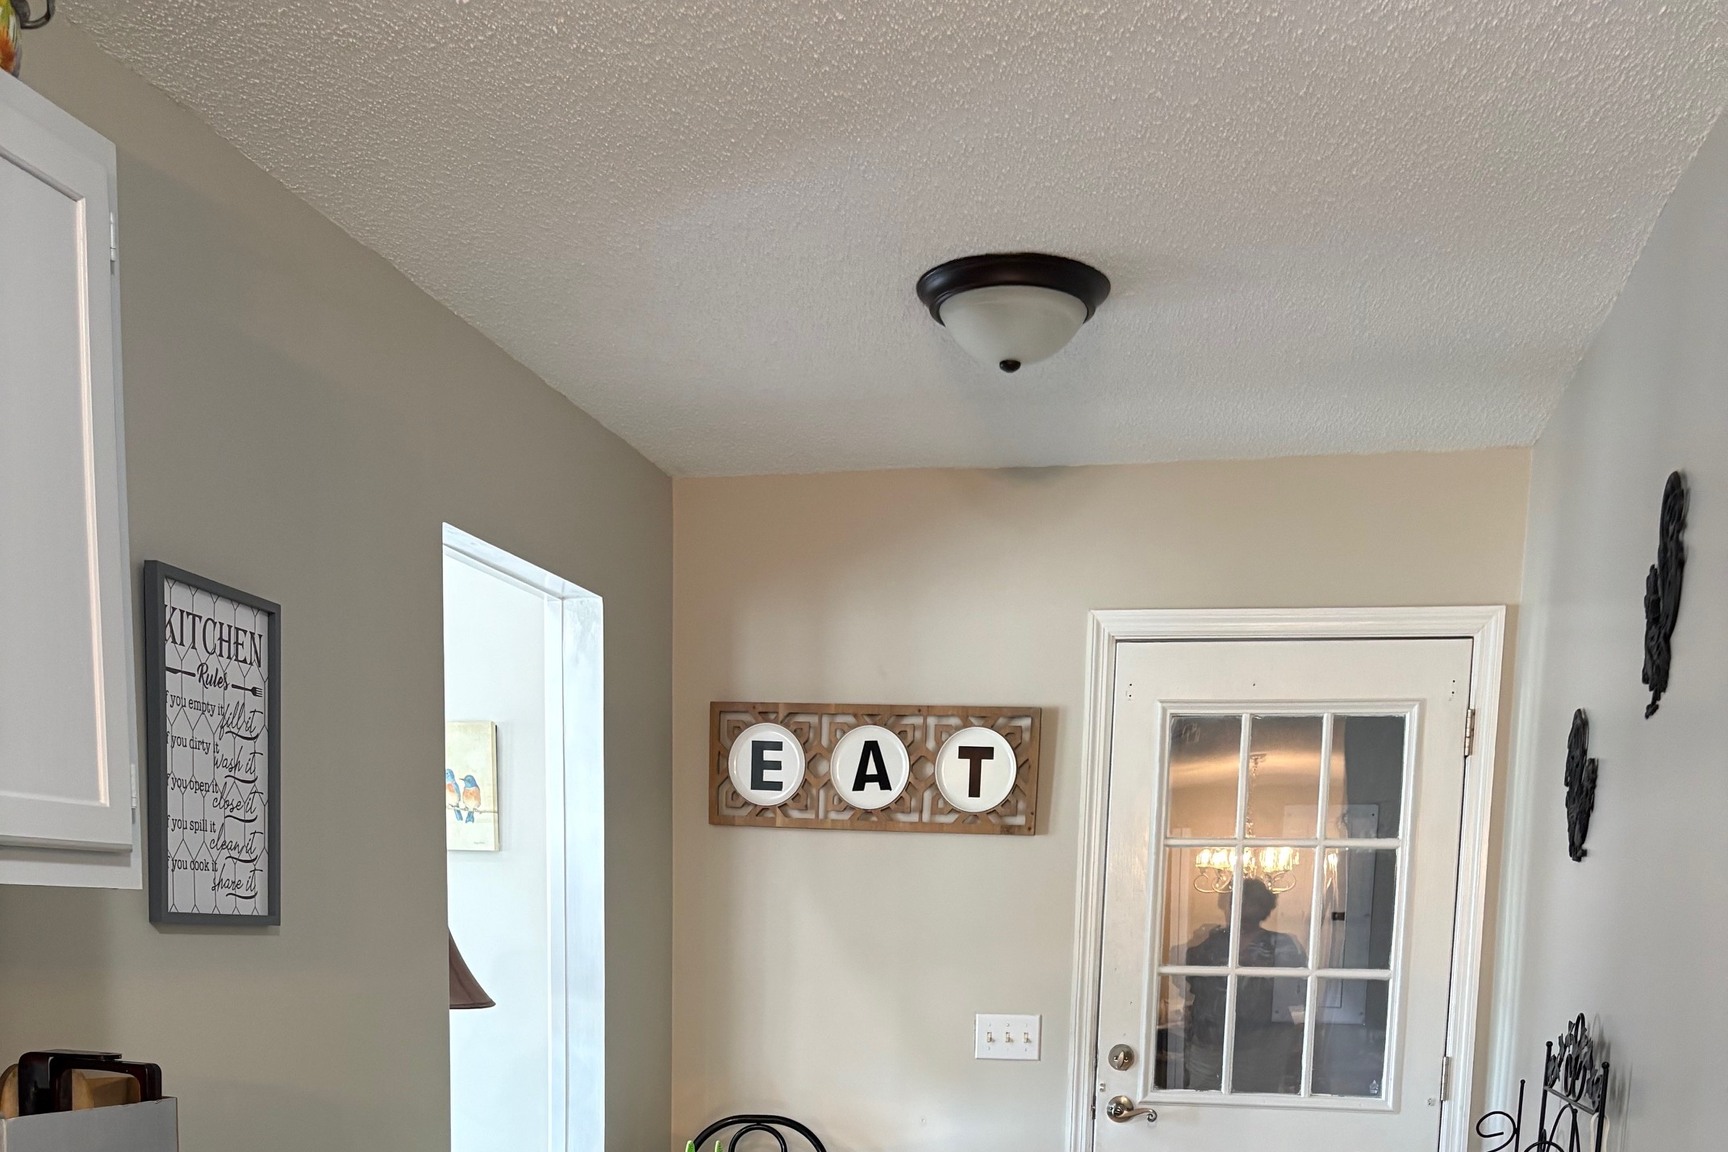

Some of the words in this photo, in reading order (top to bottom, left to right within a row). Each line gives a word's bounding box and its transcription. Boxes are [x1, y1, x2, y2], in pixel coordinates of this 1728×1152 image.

[165, 604, 263, 668] KITCHEN
[197, 662, 230, 691] Rules
[169, 694, 187, 708] you
[188, 698, 216, 717] empty
[217, 703, 225, 716] it
[219, 701, 245, 740] fill
[245, 709, 263, 733] it
[171, 735, 187, 749] you
[189, 737, 211, 755] dirty
[213, 741, 220, 754] it
[214, 745, 243, 773] wash
[245, 750, 263, 775] it
[750, 740, 994, 798] EAT
[171, 776, 187, 791] you
[189, 779, 210, 794] open
[212, 781, 219, 794] it
[212, 781, 244, 813] close
[246, 790, 264, 814] it
[171, 818, 188, 832] you
[189, 819, 208, 834] spill
[209, 820, 216, 833] it
[209, 823, 243, 853] clean
[246, 830, 264, 854] it
[171, 859, 188, 872] you
[189, 859, 210, 872] cook
[212, 860, 218, 872] it
[211, 863, 243, 892] share
[246, 868, 263, 892] it
